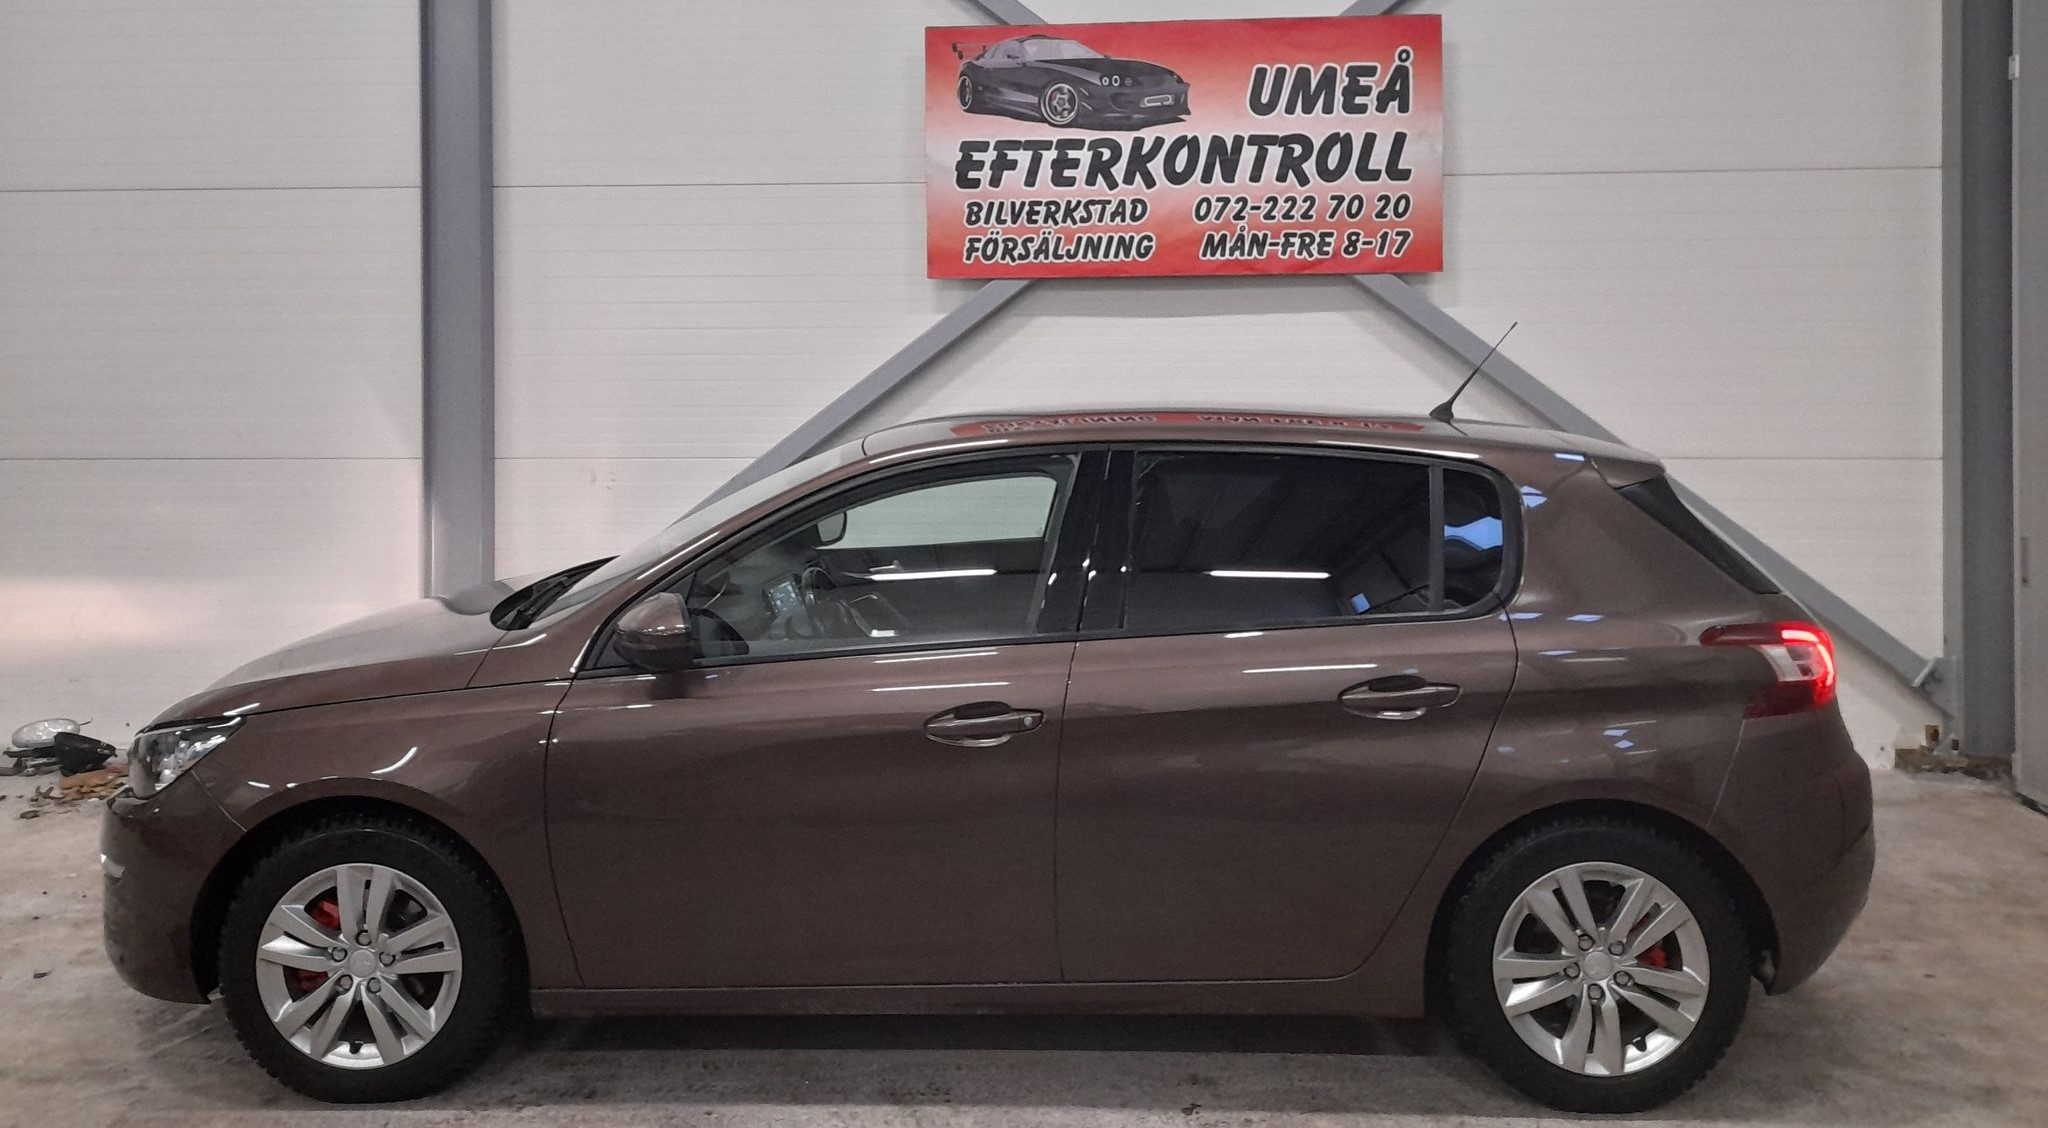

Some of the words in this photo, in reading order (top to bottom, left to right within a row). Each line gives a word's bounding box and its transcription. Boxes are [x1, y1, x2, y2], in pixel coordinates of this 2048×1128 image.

[1248, 47, 1412, 117] UMEÅ
[954, 130, 1413, 192] EFTERKONTROLL
[964, 197, 1149, 228] BILVERKSTAD
[1193, 194, 1317, 223] 072-222
[1327, 193, 1365, 221] 70
[1373, 192, 1412, 220] 20
[964, 230, 1155, 264] FÖRSÄLJNING
[1200, 224, 1334, 260] MÅN-FRE
[1342, 229, 1412, 257] 8-17
